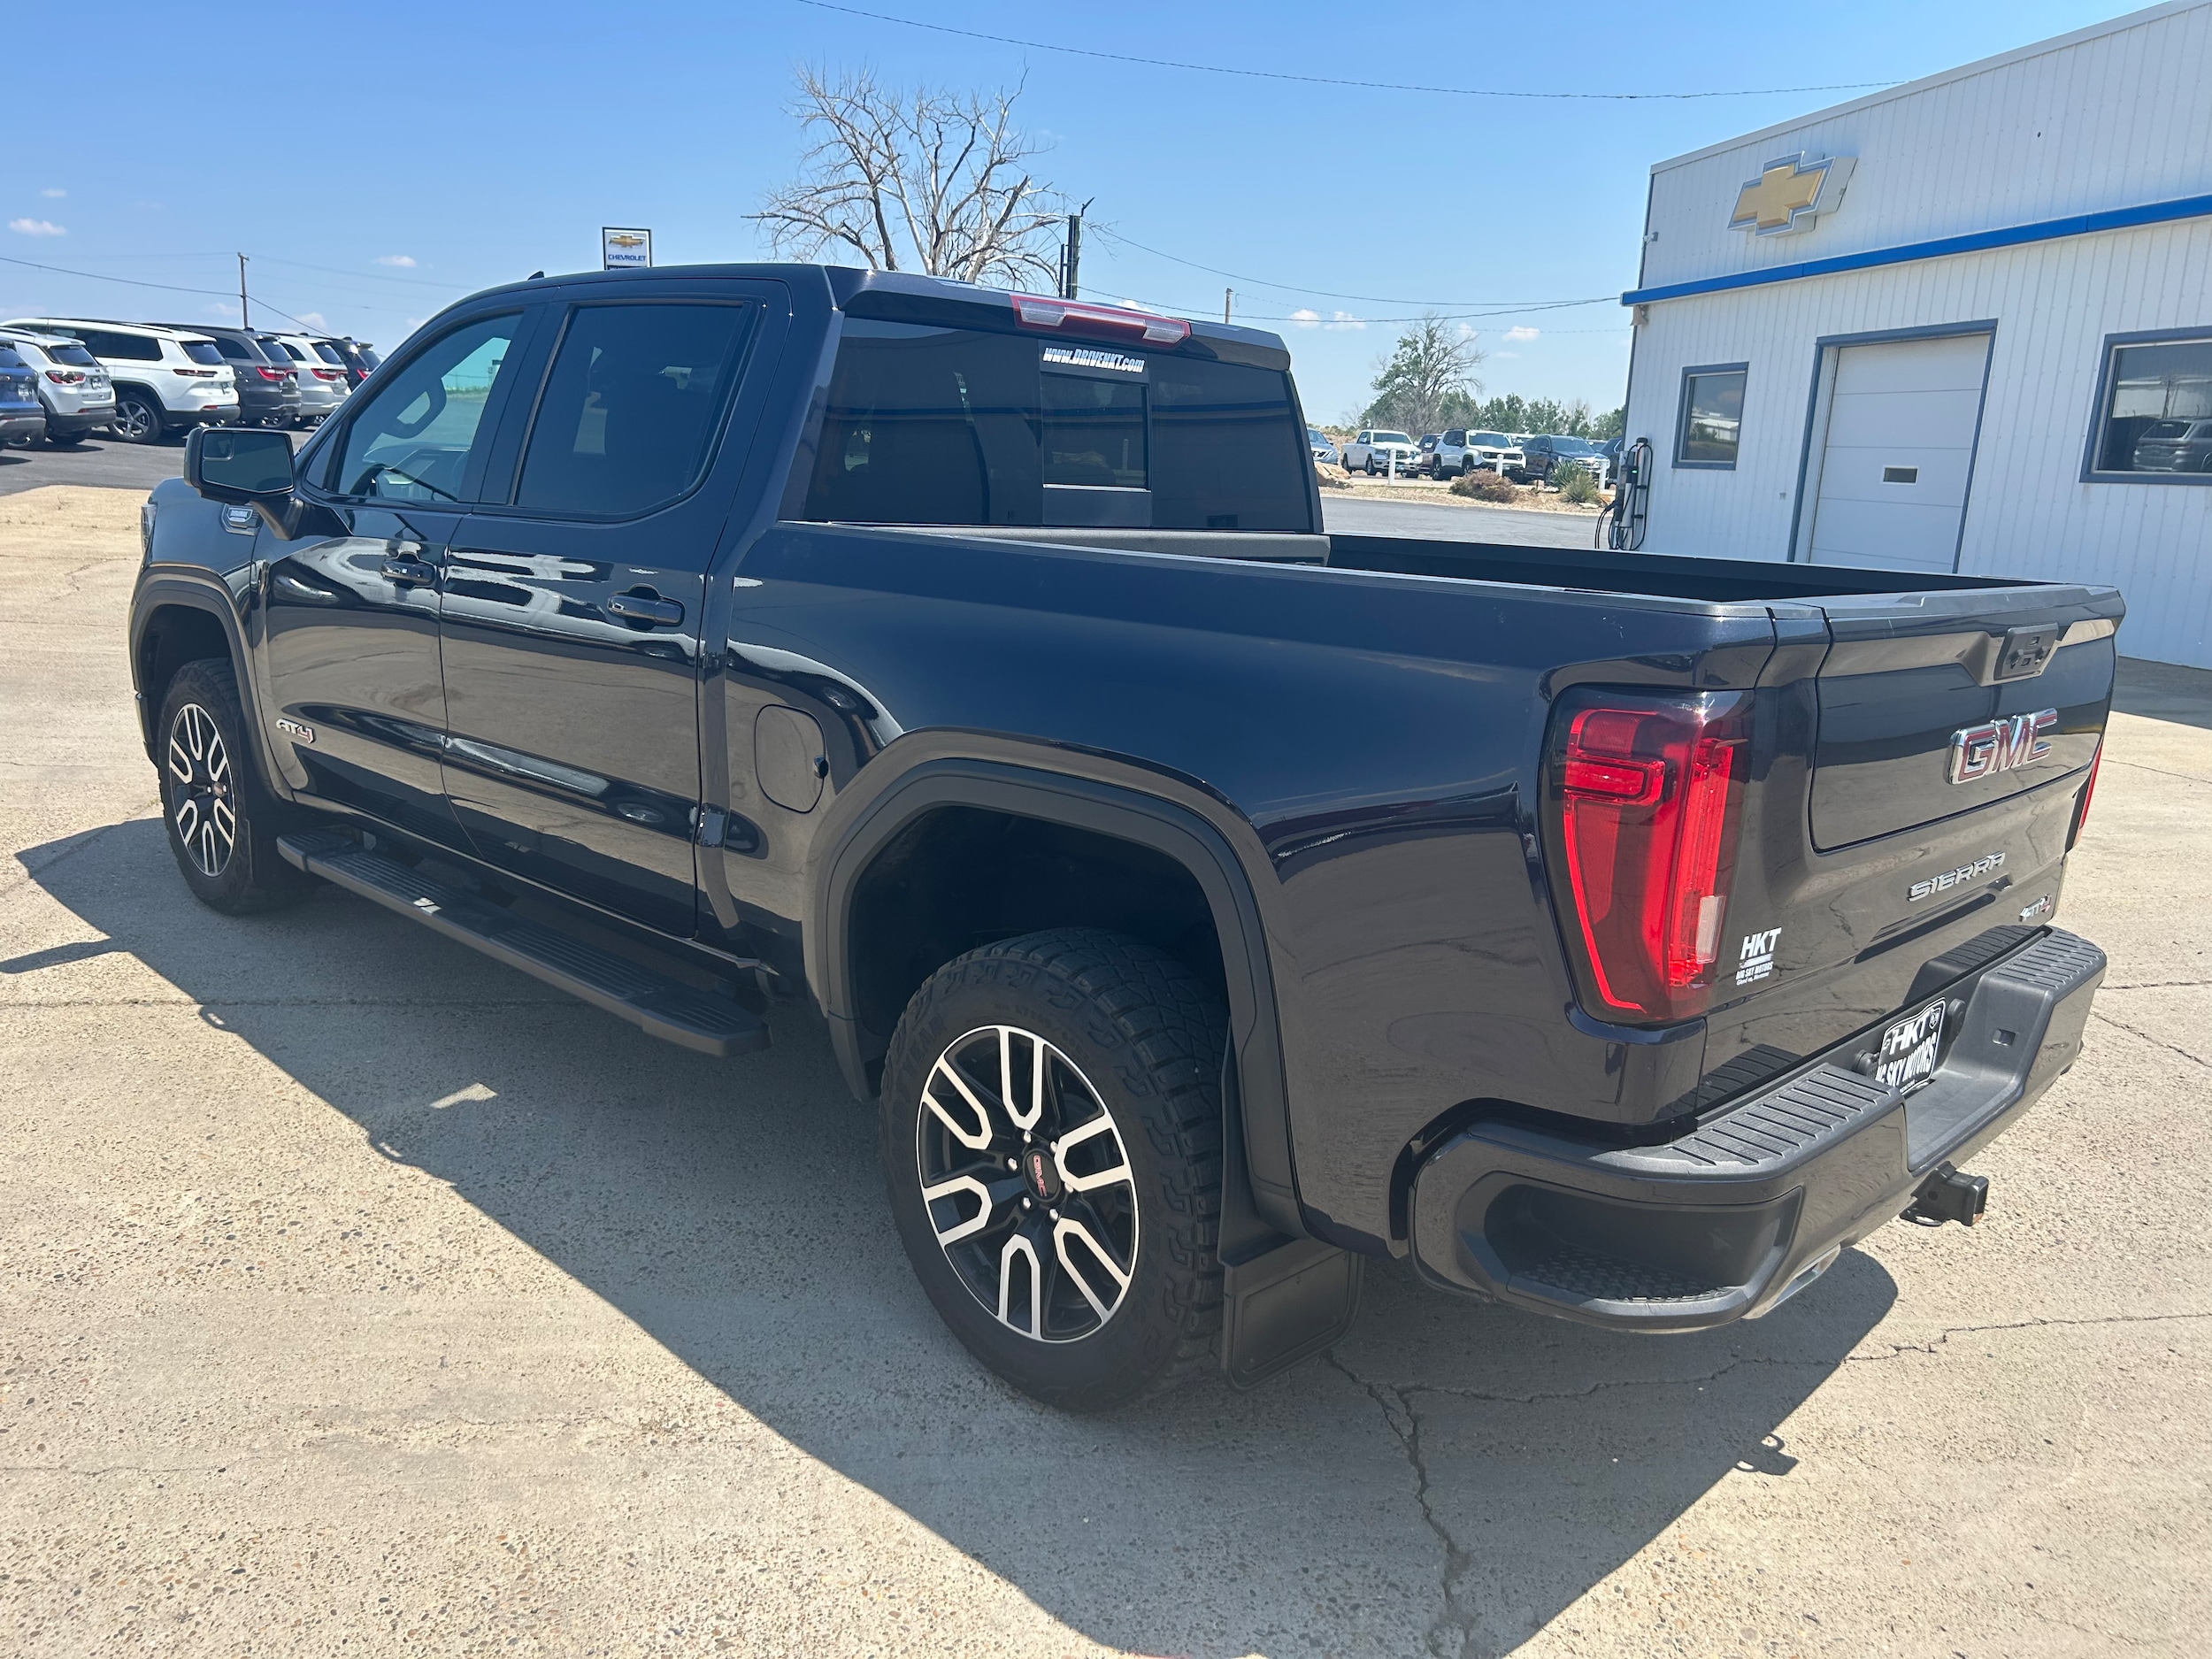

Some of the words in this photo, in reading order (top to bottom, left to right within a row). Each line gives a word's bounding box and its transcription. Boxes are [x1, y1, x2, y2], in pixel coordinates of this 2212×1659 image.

[276, 718, 314, 744] AT4
[1947, 708, 2058, 785] GMC
[1908, 850, 2006, 902] SIERRA
[1740, 926, 1782, 960] HKT
[1890, 1009, 1931, 1055] HKT
[1886, 1057, 1908, 1087] SKY
[1901, 1032, 1938, 1082] MOTORS
[1033, 1155, 1048, 1197] GMC
